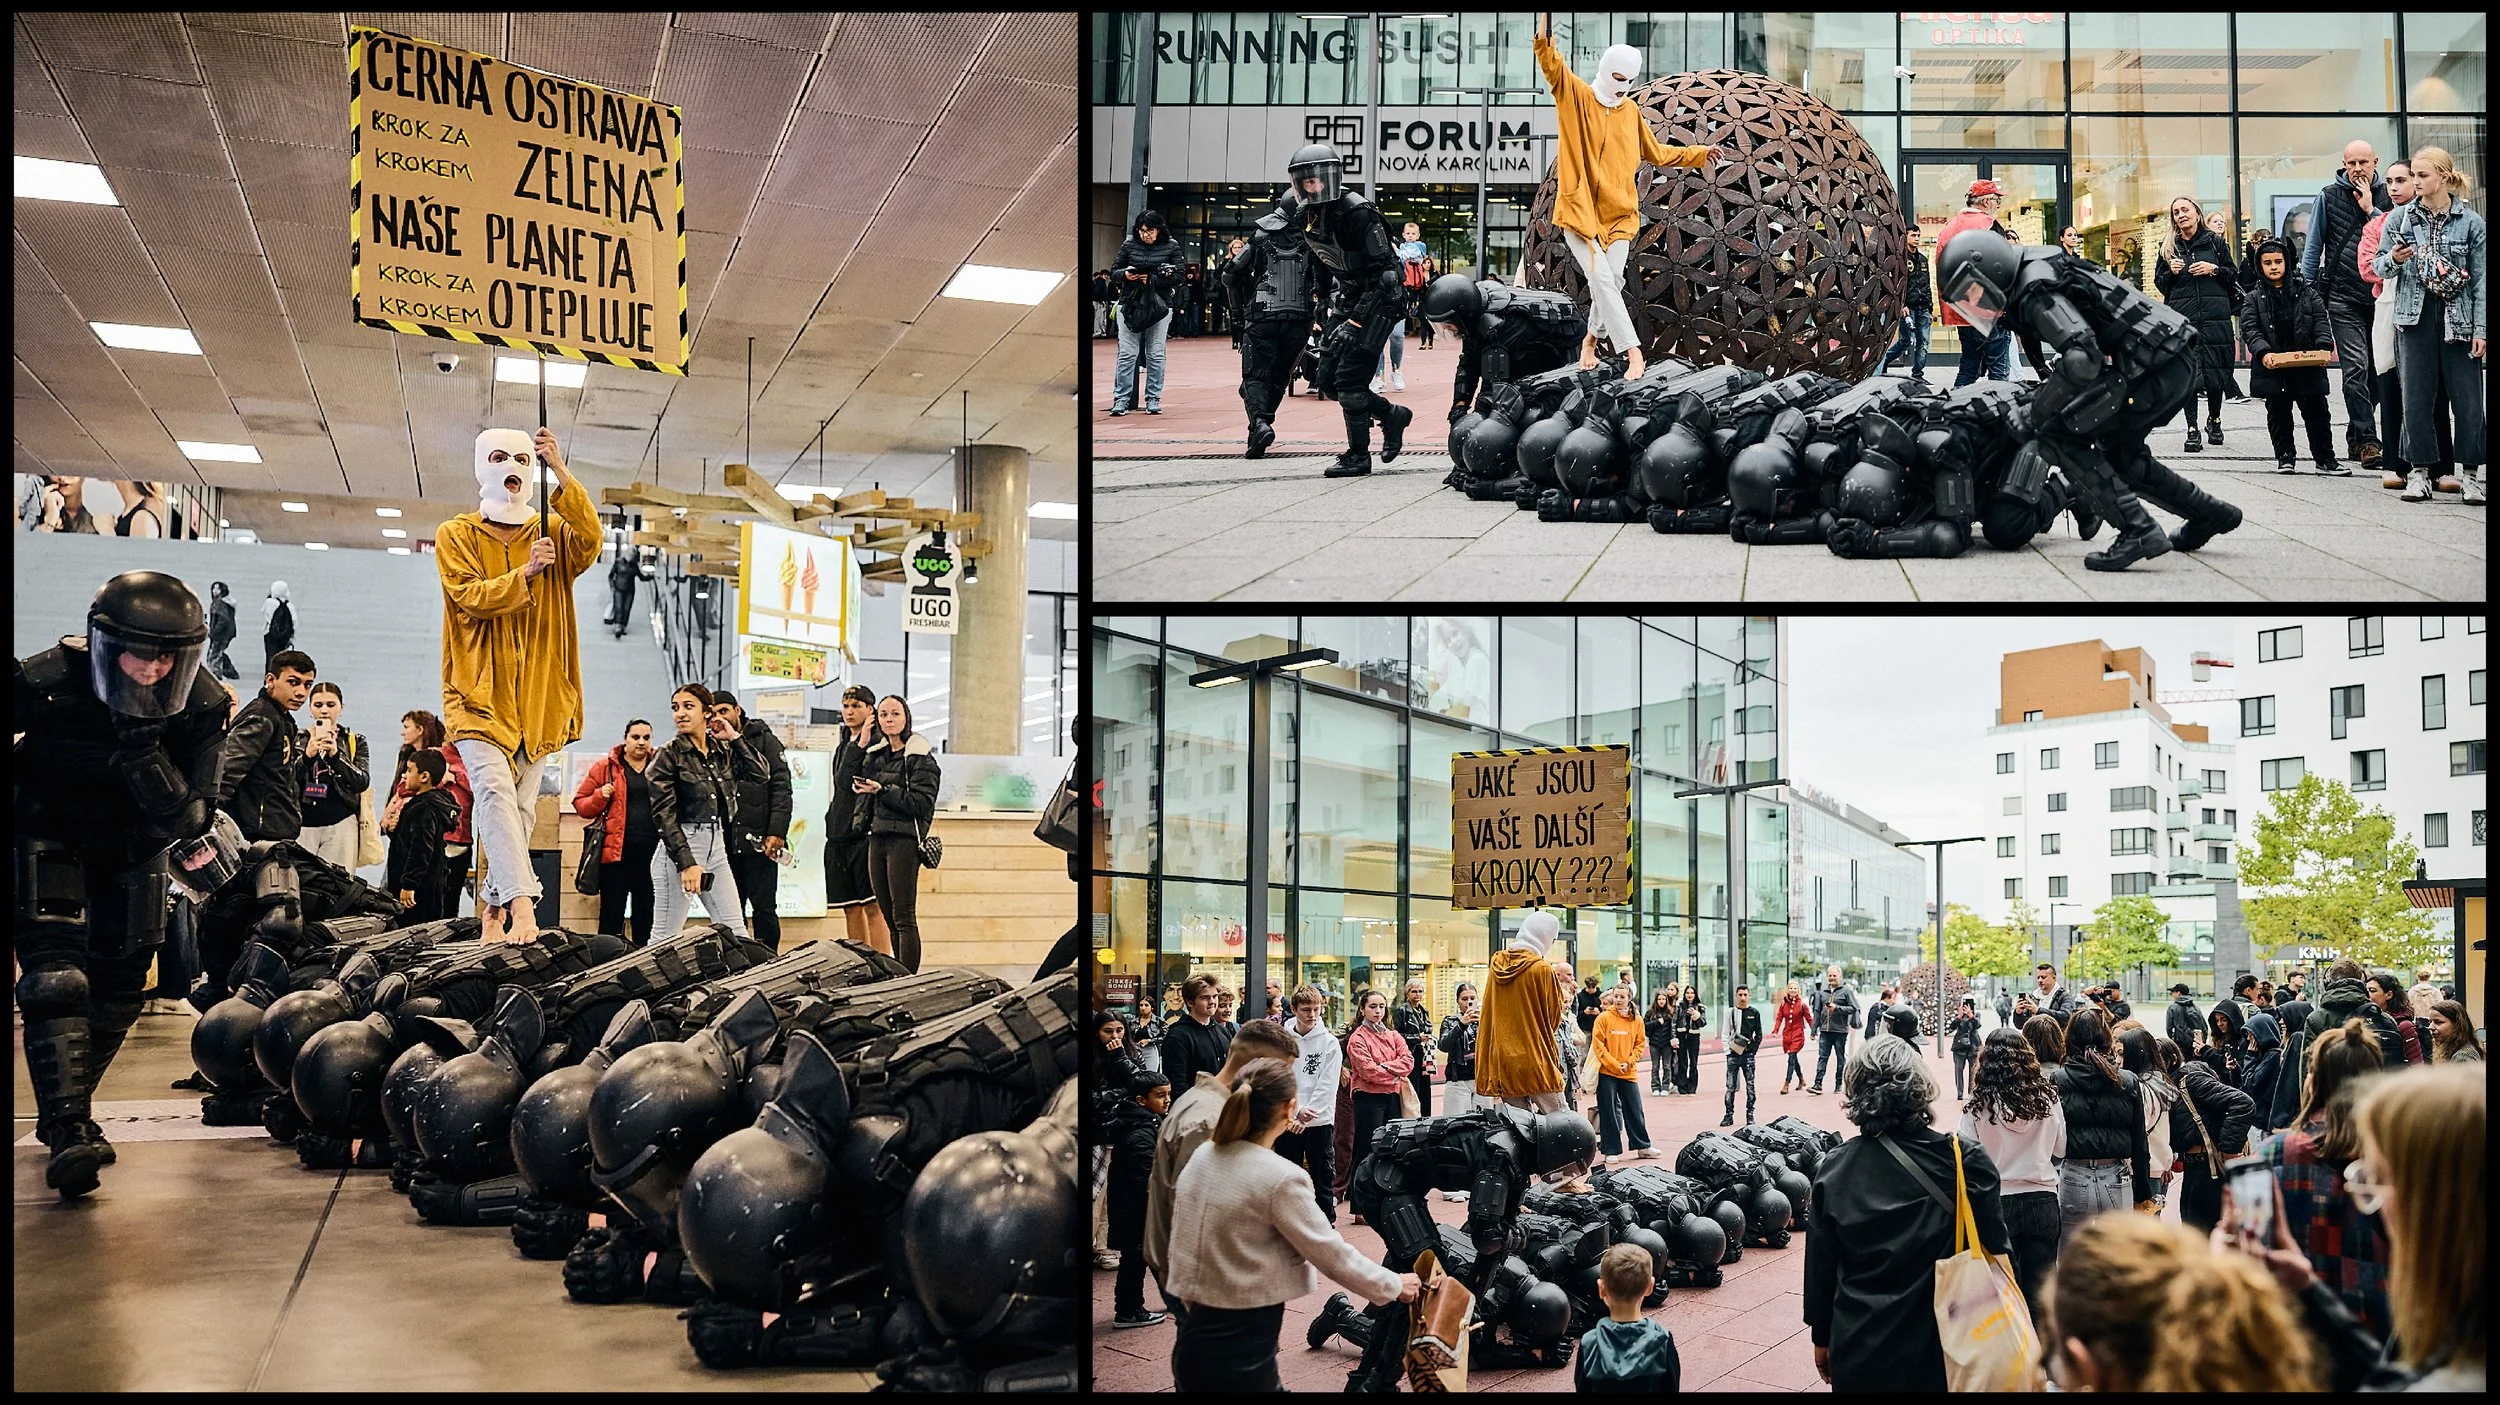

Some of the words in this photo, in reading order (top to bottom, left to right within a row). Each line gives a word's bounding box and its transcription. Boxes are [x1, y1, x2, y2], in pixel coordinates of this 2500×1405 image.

[1378, 30, 1509, 65] SUSHI
[1931, 28, 2025, 45] OPTIKA
[367, 31, 494, 116] ČERNÁ
[504, 71, 668, 163] OSTRAVA
[371, 109, 433, 140] KROK
[440, 124, 472, 147] ZA
[1380, 121, 1531, 151] FORUM
[375, 148, 473, 182] KROKEM
[1379, 153, 1430, 171] NOVÁ
[514, 140, 668, 232] ZELENÁ
[371, 194, 462, 257] NAŠE
[485, 213, 636, 293] PLANETA
[378, 263, 441, 289] KROK
[446, 274, 477, 294] ZA
[380, 295, 483, 325] KROKEM
[488, 279, 654, 353] OTEPLUJE
[915, 558, 951, 572] UGO
[909, 618, 951, 628] FRESHBAR
[911, 598, 952, 617] UGO
[1467, 758, 1519, 799] JAKÉ
[1536, 759, 1595, 796] JSOU
[1468, 808, 1522, 851] VAŠE
[1534, 802, 1604, 849] DALŠÍ
